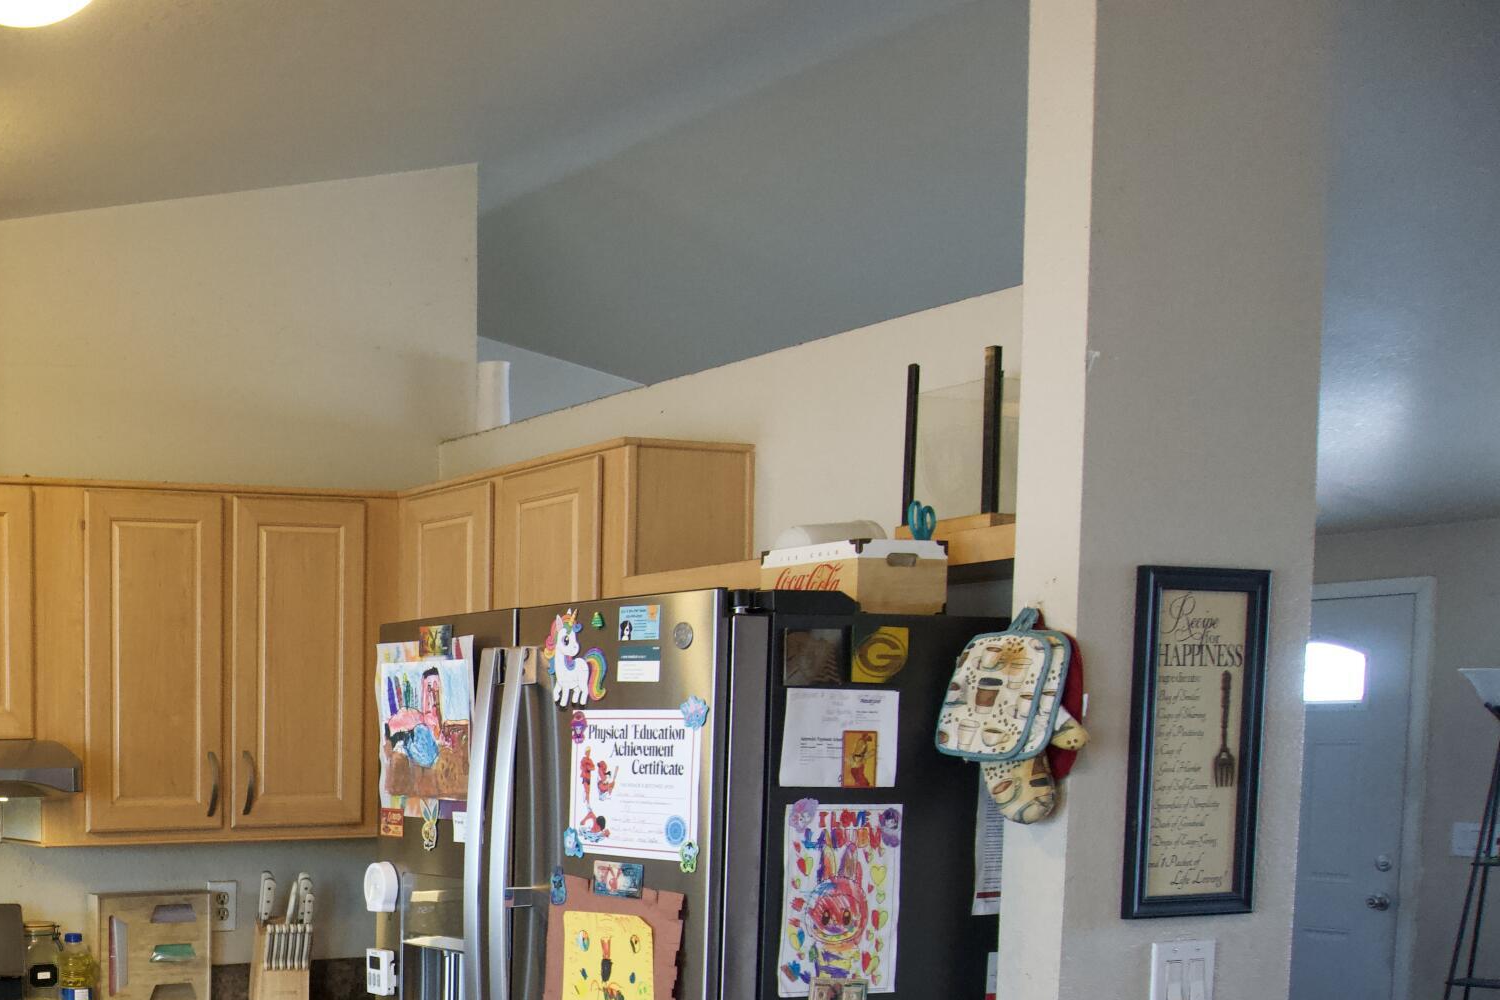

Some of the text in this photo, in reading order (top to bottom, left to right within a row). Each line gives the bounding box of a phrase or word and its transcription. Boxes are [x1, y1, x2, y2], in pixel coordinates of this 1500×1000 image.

[1161, 591, 1220, 645] Recipe
[1158, 642, 1243, 667] HAPPINESS
[588, 724, 685, 743] Physical Education
[609, 741, 674, 758] Achievement
[631, 759, 684, 776] Certificate
[818, 809, 872, 829] I LOVE
